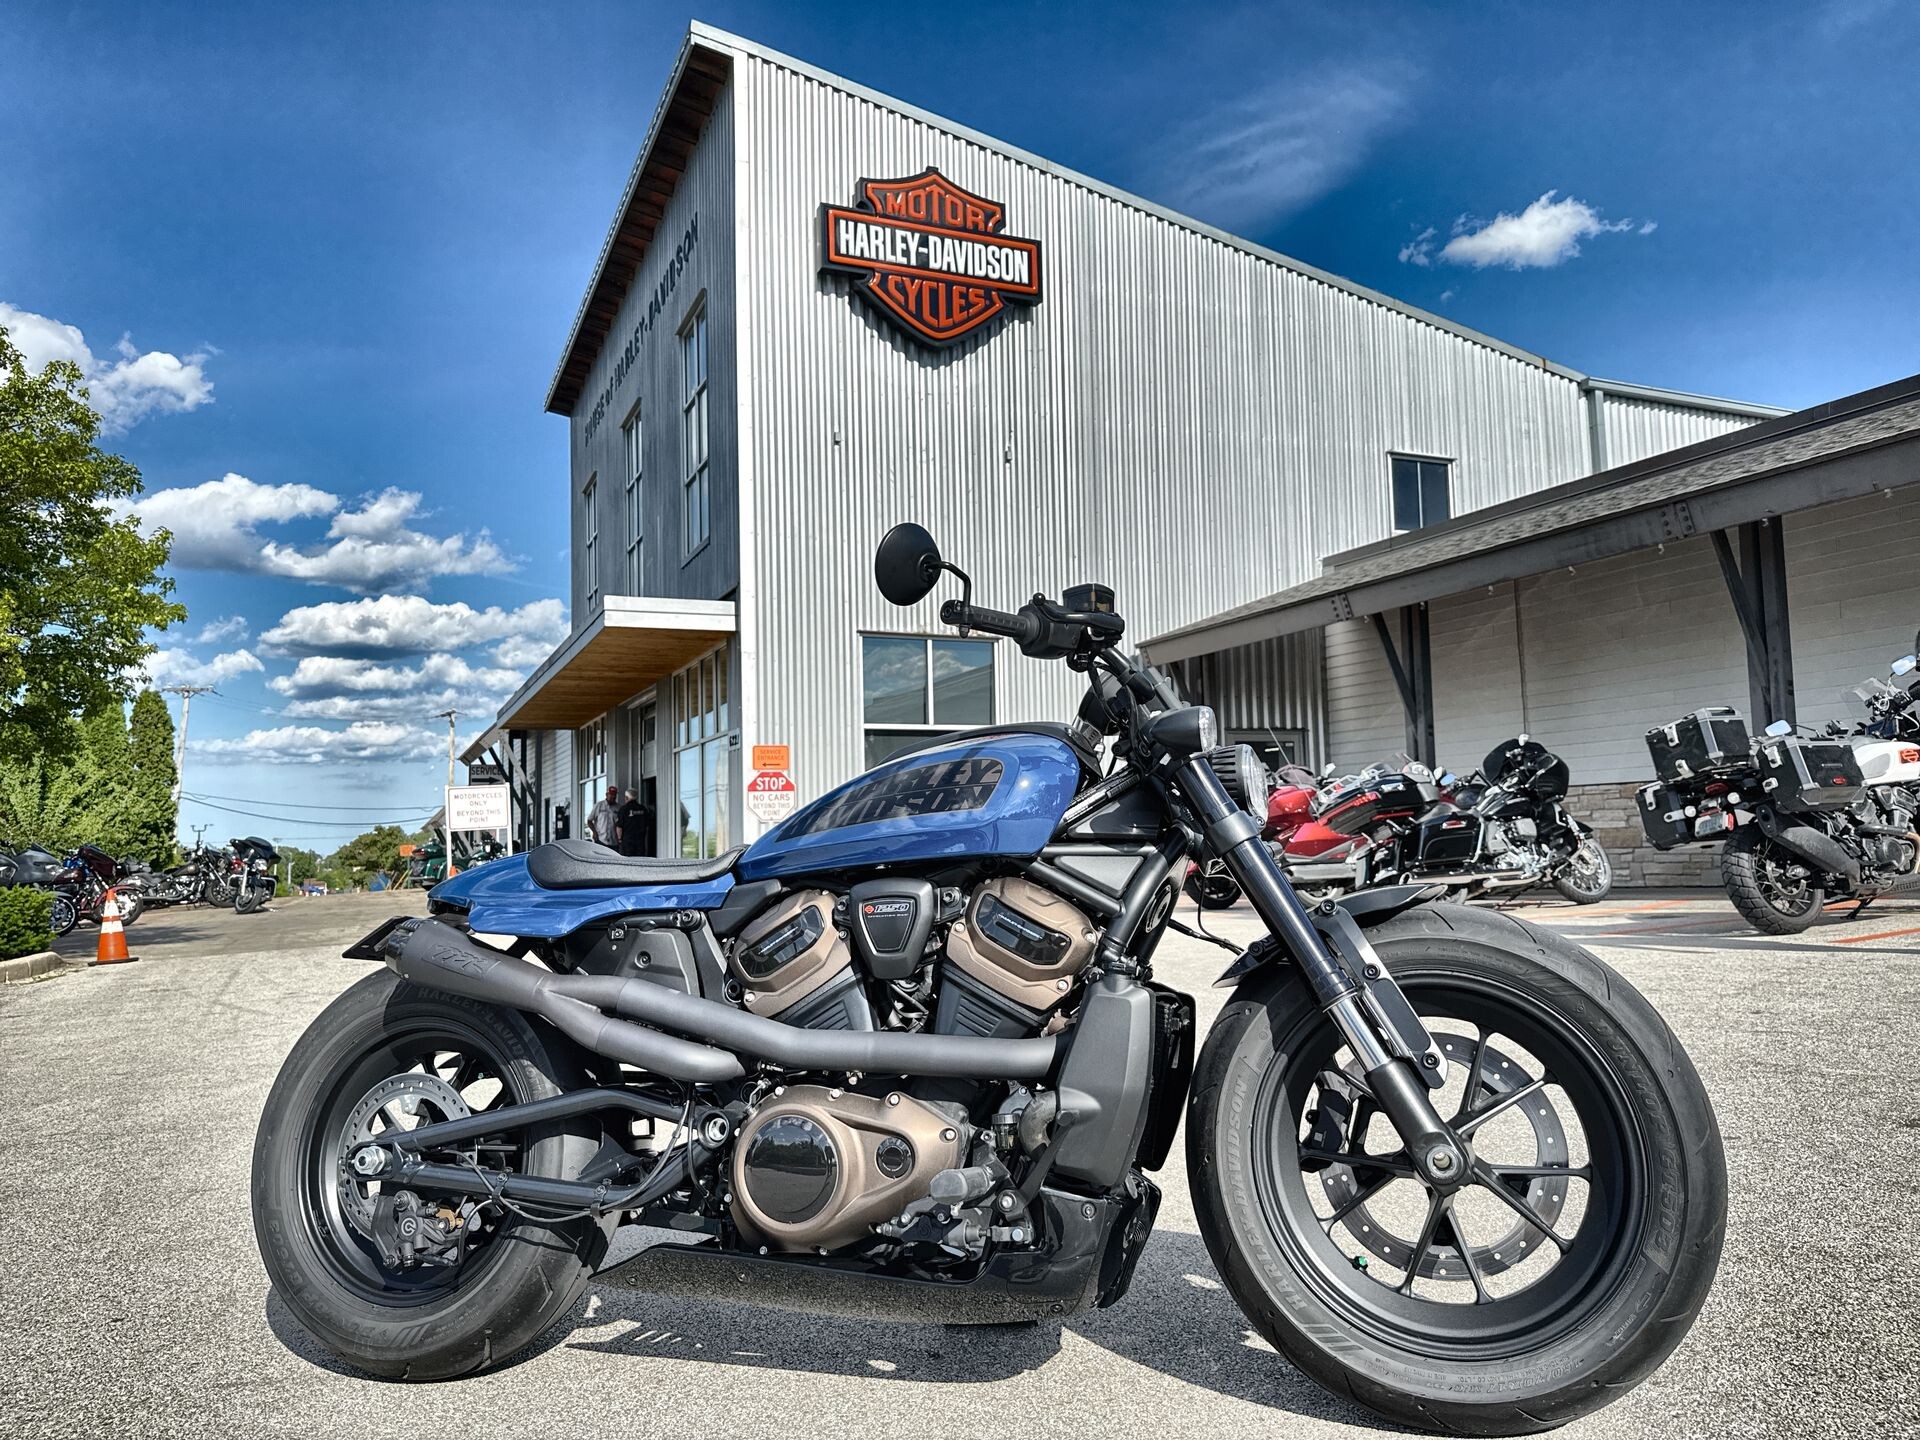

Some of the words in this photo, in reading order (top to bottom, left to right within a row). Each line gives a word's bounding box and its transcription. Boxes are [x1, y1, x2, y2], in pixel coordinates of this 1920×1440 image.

[886, 184, 985, 231] MOTOR
[839, 219, 1029, 284] HARLEY-DAVIDSON
[614, 211, 698, 392] HARLEY-DAVIDSON
[888, 275, 985, 327] CYCLES
[755, 777, 787, 790] STOP
[768, 793, 790, 801] CARS
[1227, 1076, 1308, 1312] HARLEY-DAVIDSON
